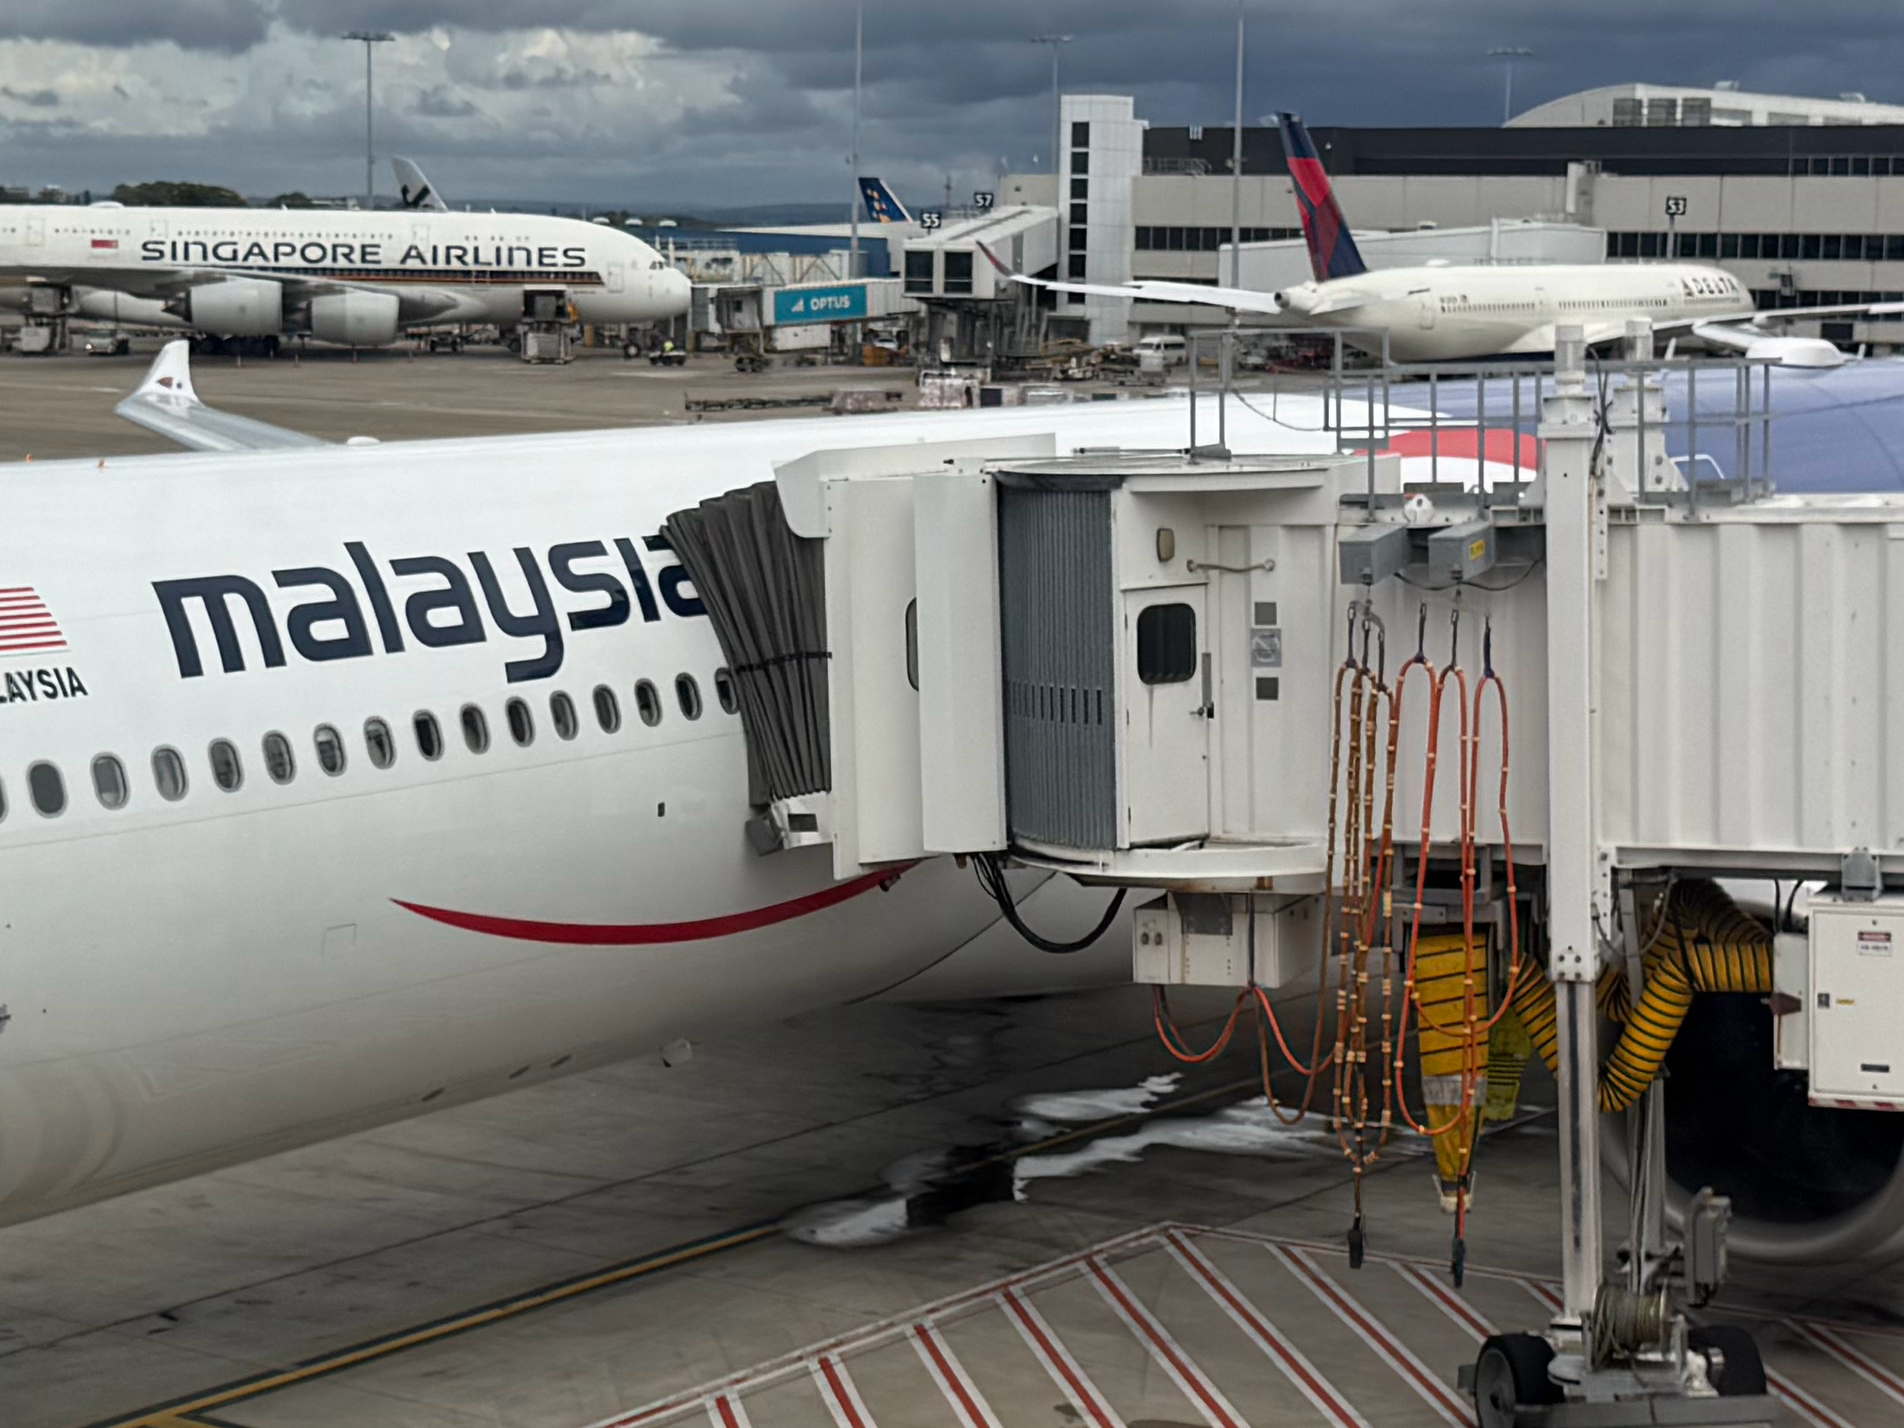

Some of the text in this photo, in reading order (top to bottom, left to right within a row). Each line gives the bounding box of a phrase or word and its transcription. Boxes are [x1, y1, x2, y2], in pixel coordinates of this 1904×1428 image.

[141, 241, 587, 268] SINGAPORE AIRLINES
[1691, 276, 1739, 295] DELTA
[810, 295, 851, 311] OPTUS
